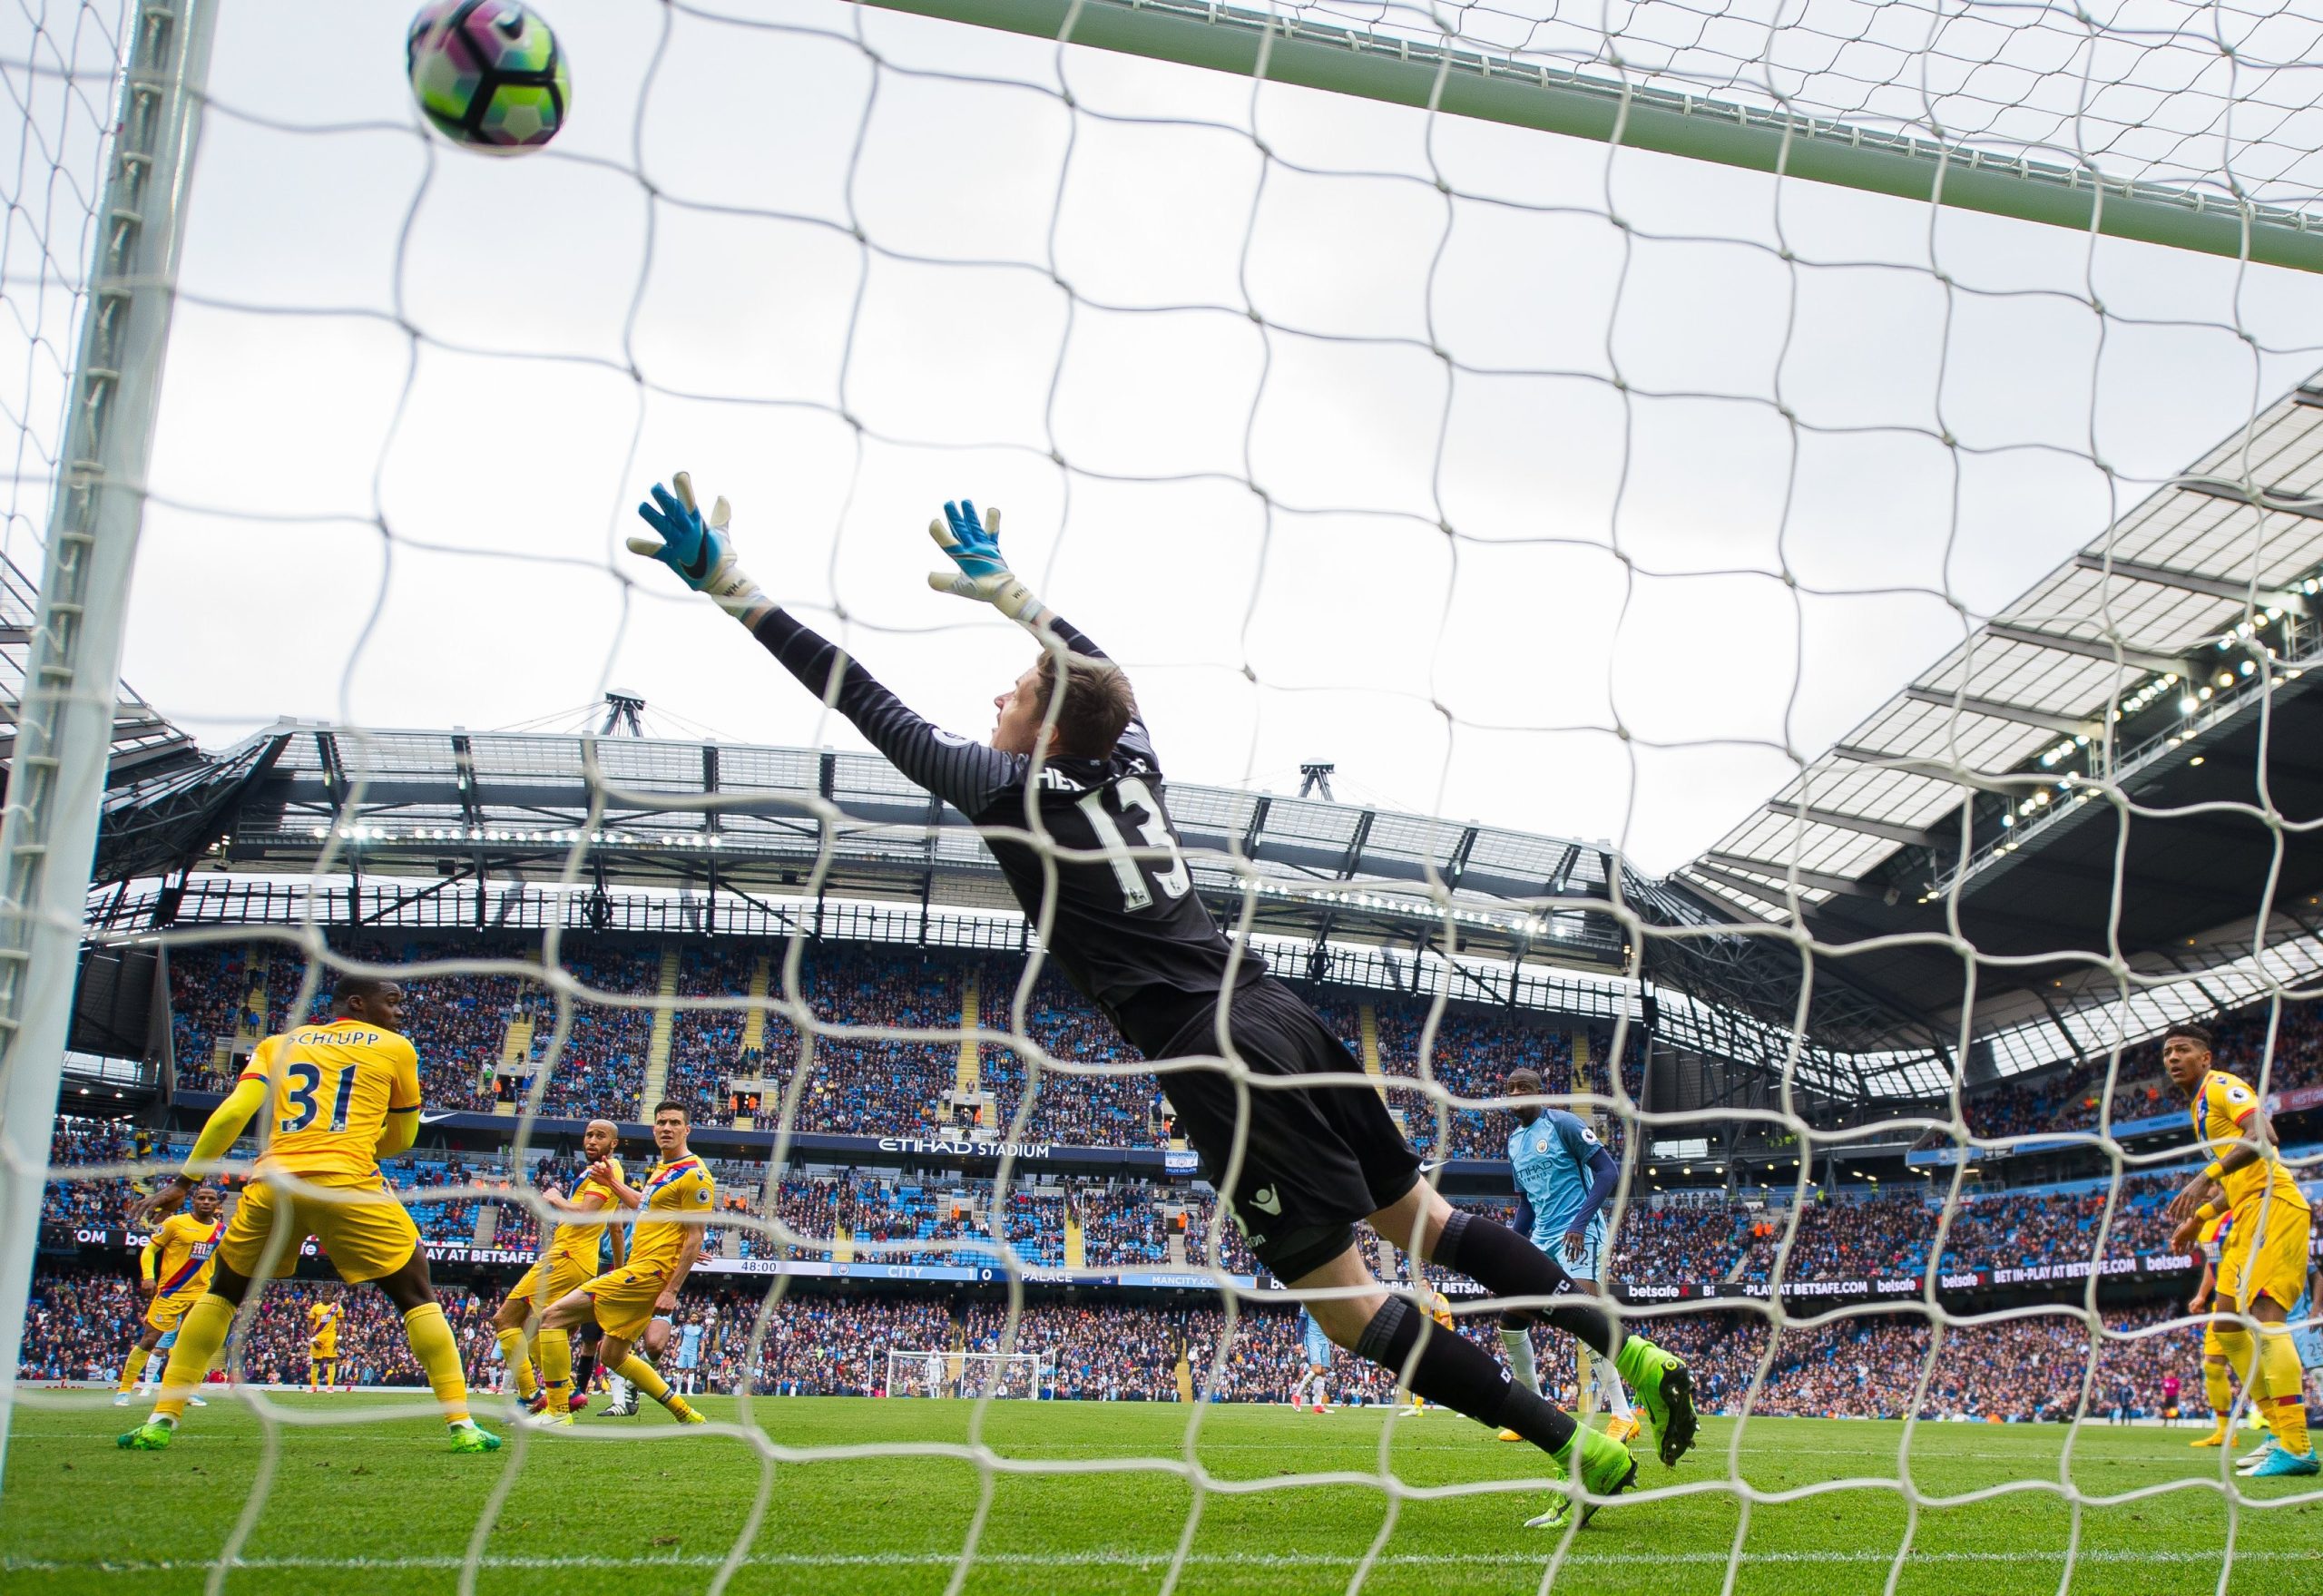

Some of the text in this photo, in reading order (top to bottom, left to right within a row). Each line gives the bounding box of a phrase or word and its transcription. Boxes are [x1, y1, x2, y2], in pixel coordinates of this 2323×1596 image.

[1074, 777, 1191, 913] 13
[281, 1062, 357, 1132] 31
[878, 1138, 1049, 1158] ETIHAD STADIUM
[448, 1249, 468, 1261] AT
[741, 1261, 777, 1272] 48:00
[887, 1267, 923, 1278] CITY
[982, 1269, 992, 1280] 0
[1022, 1271, 1073, 1282] PALACE
[1152, 1276, 1218, 1287] MANCITY.CO
[1942, 1273, 1977, 1288] betsafe
[1995, 1270, 2011, 1283] BET
[2053, 1266, 2065, 1278] AT
[1629, 1285, 1679, 1297] betsafe
[1779, 1284, 1792, 1296] AT
[1794, 1281, 1867, 1295] BETSAFE.COM
[1877, 1279, 1916, 1293] betsafe
